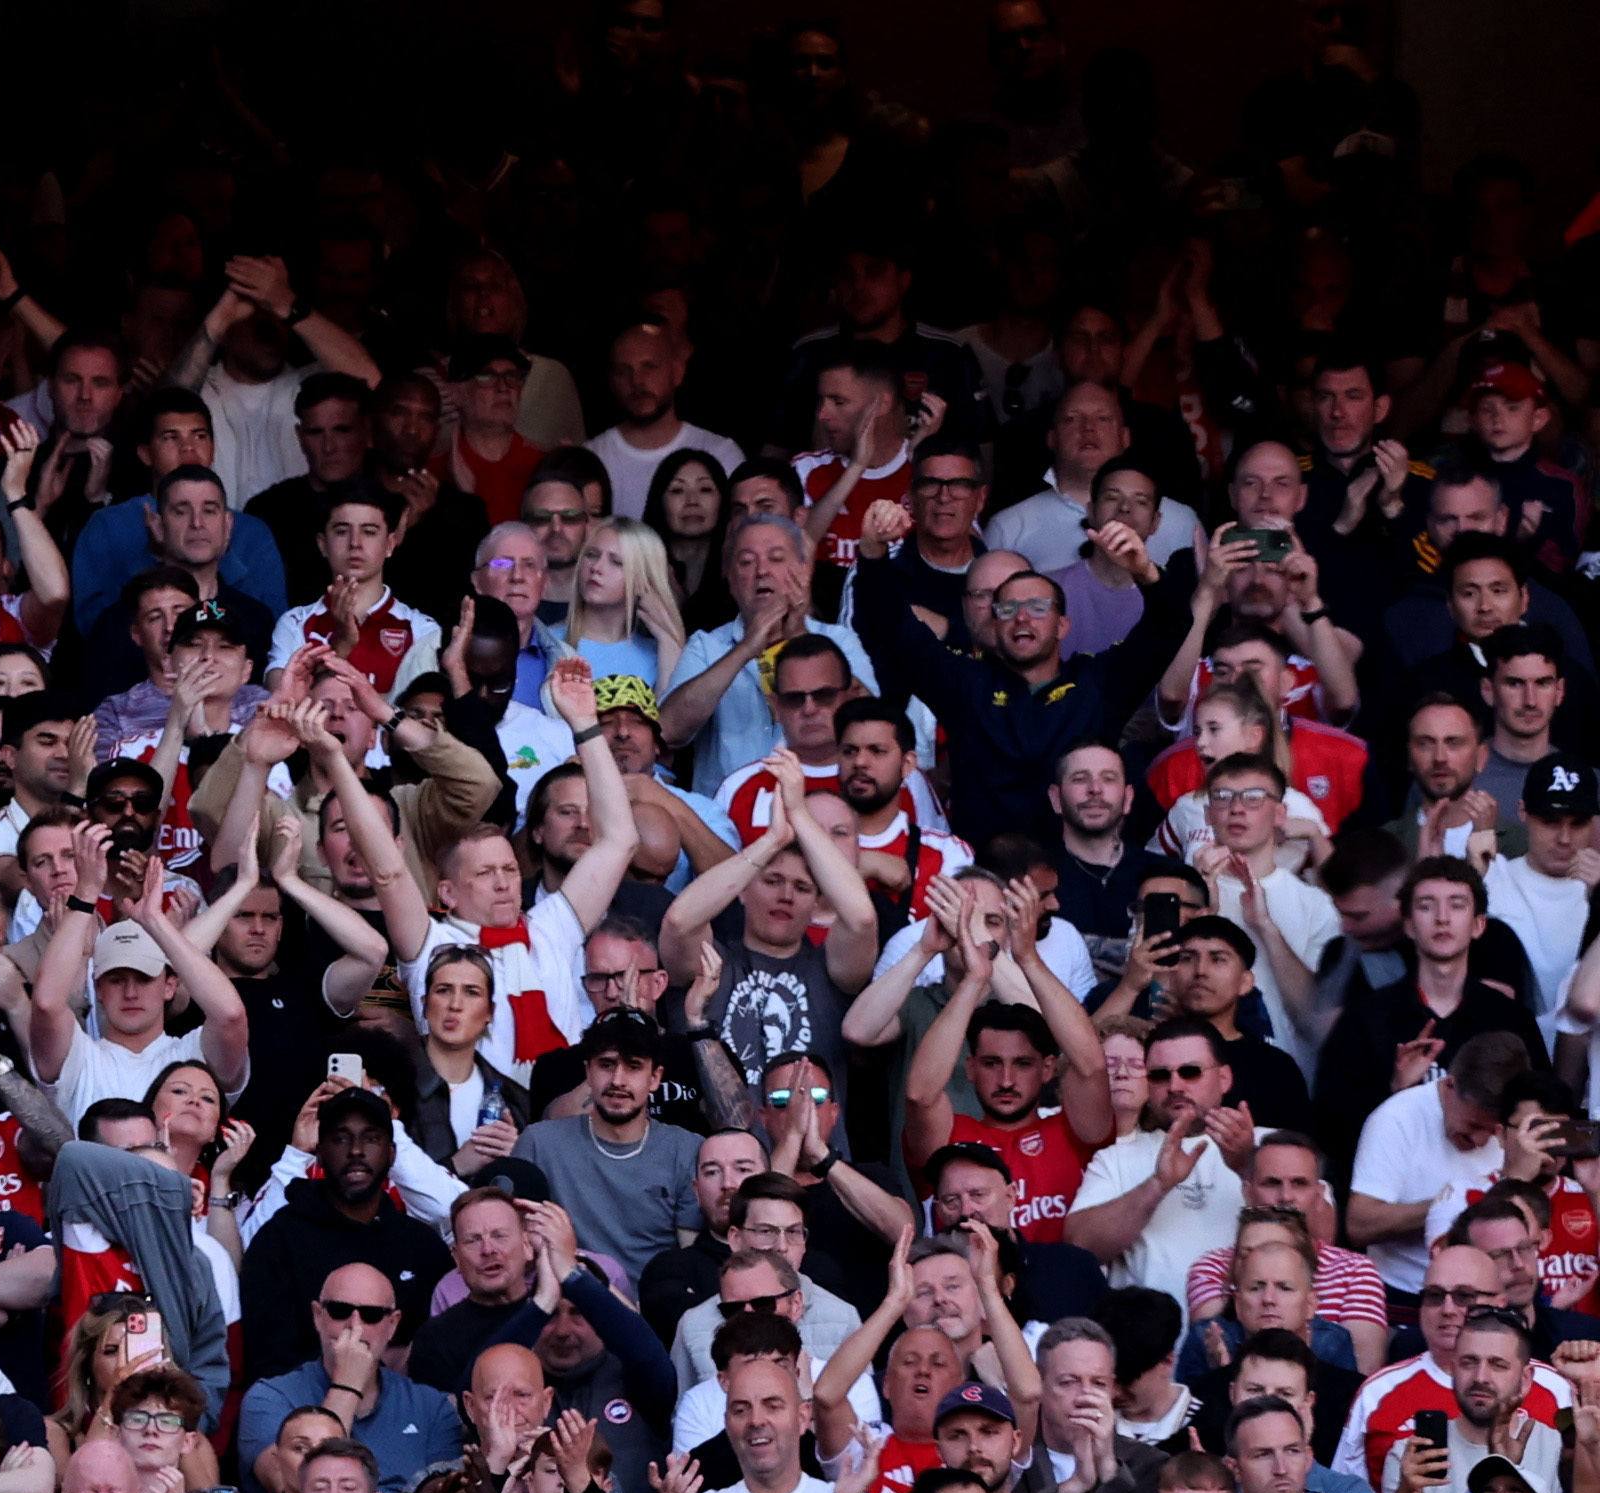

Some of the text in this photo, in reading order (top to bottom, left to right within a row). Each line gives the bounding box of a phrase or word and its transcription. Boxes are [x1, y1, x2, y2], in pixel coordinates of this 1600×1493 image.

[663, 1082, 698, 1102] Dio
[1010, 1195, 1066, 1229] rates
[1537, 1254, 1599, 1278] rates
